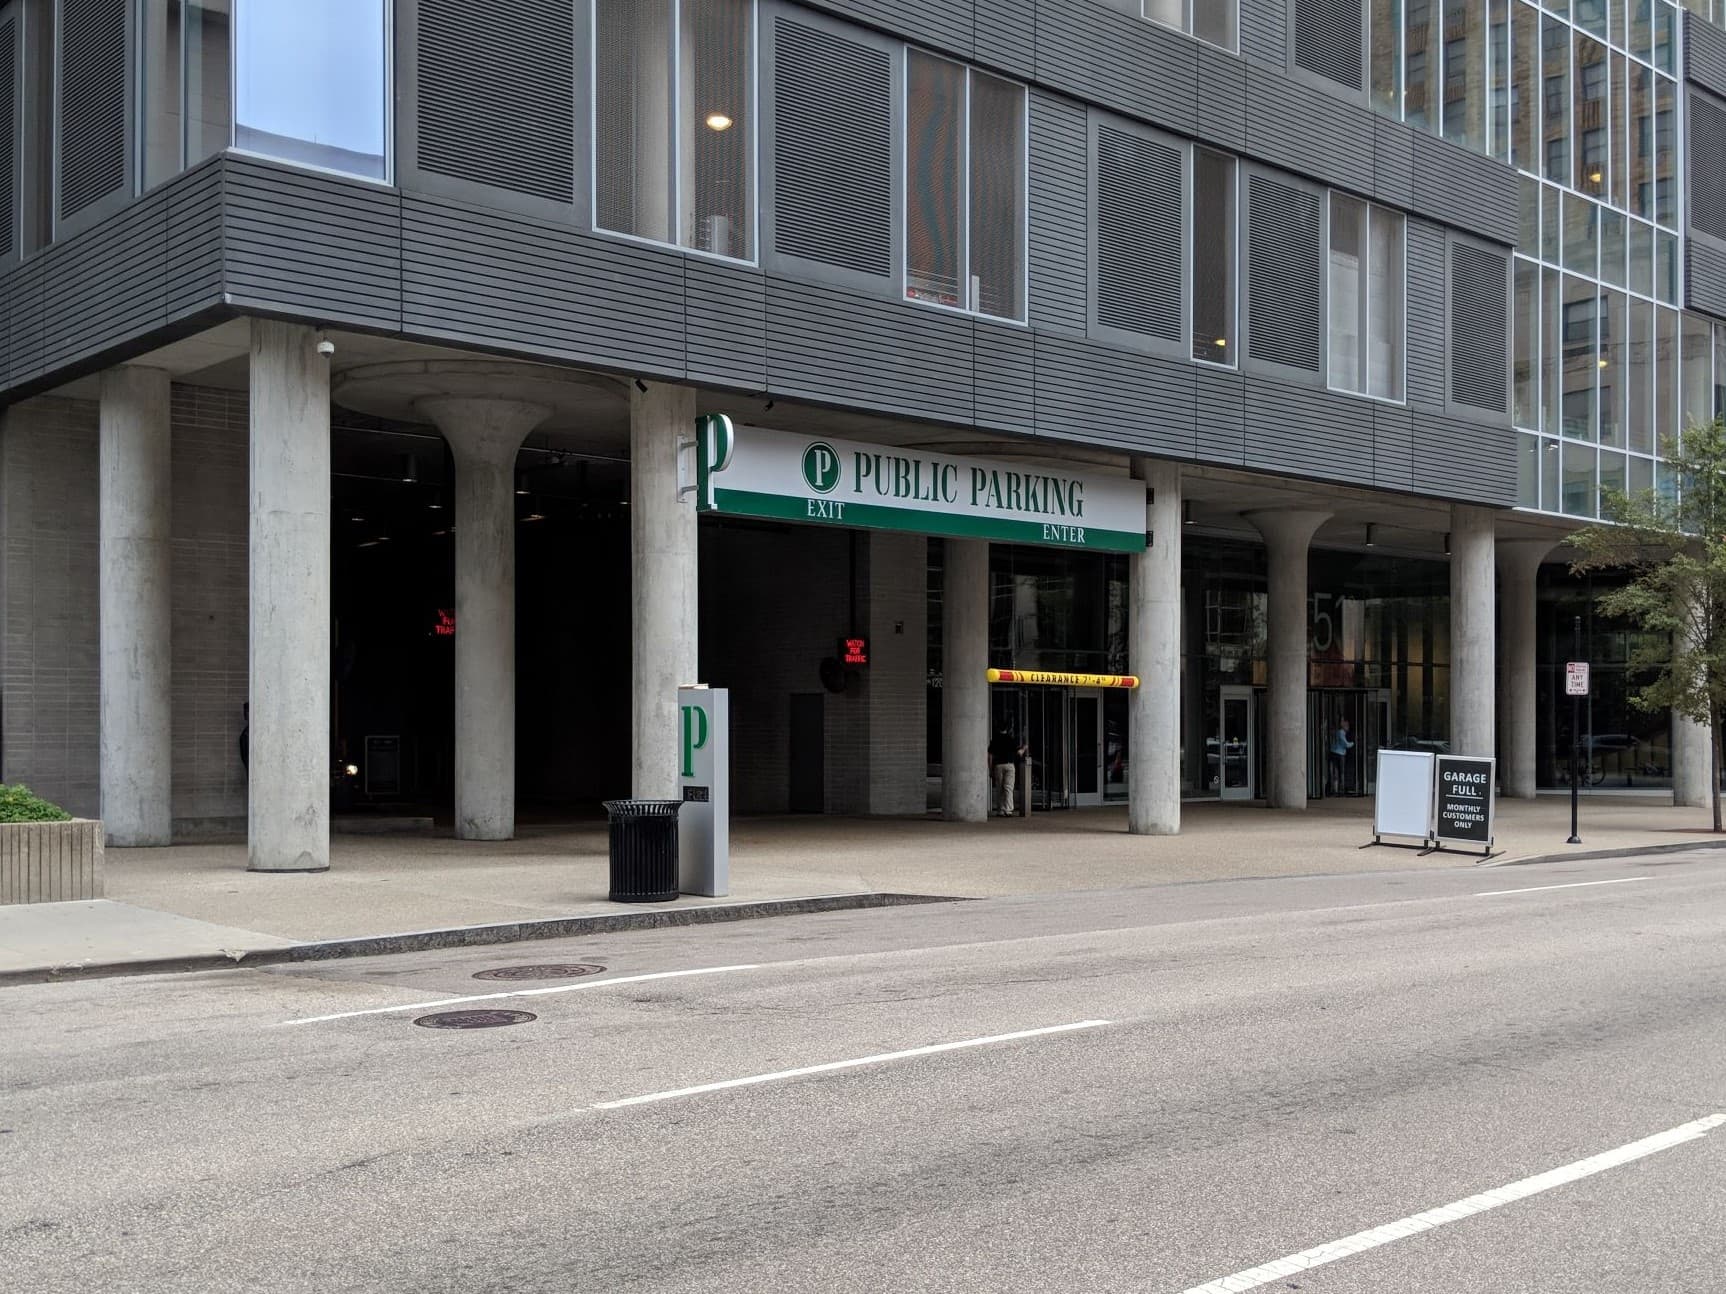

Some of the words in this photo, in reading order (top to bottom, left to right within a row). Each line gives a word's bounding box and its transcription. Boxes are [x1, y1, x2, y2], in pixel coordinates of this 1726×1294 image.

[696, 413, 734, 511] P
[814, 449, 832, 486] P
[853, 451, 958, 503] PUBLIC
[970, 467, 1084, 518] PARKING
[808, 499, 845, 519] EXIT
[1043, 524, 1086, 543] ENTER
[846, 639, 865, 648] WATCH
[850, 647, 861, 655] FOR
[844, 654, 867, 663] TRAFFIC
[1030, 673, 1080, 684] CLEARANCE
[681, 706, 708, 777] P
[1443, 771, 1487, 784] GARAGE
[1452, 784, 1477, 796] FULL
[1447, 803, 1481, 813] MONTHLY
[1442, 811, 1485, 822] CUSTOMERS
[1454, 820, 1472, 829] ONLY
